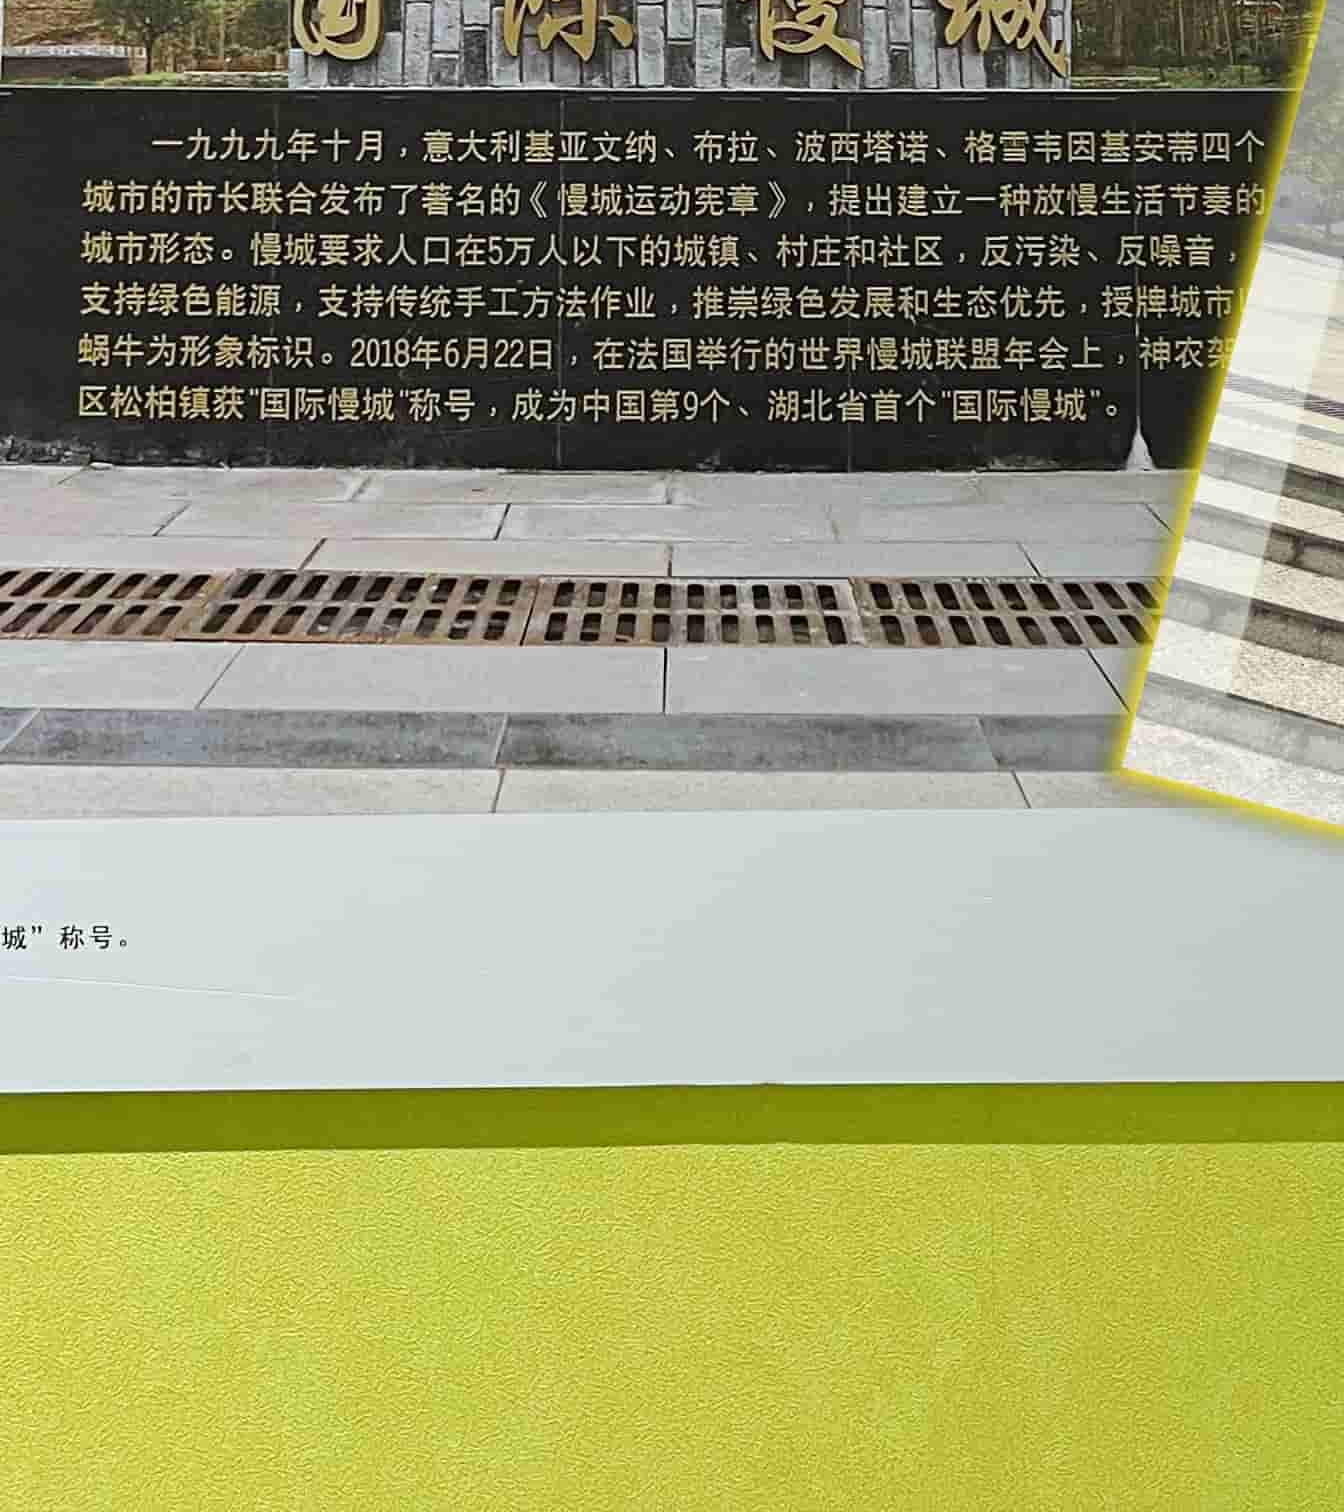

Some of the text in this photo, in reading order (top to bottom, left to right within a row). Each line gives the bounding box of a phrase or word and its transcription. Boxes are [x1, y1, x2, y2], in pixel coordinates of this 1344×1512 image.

[79, 283, 1248, 319] 支持绿色能源，支持传统手工方法作业，推崇绿色发展和生态优先，授牌城市
